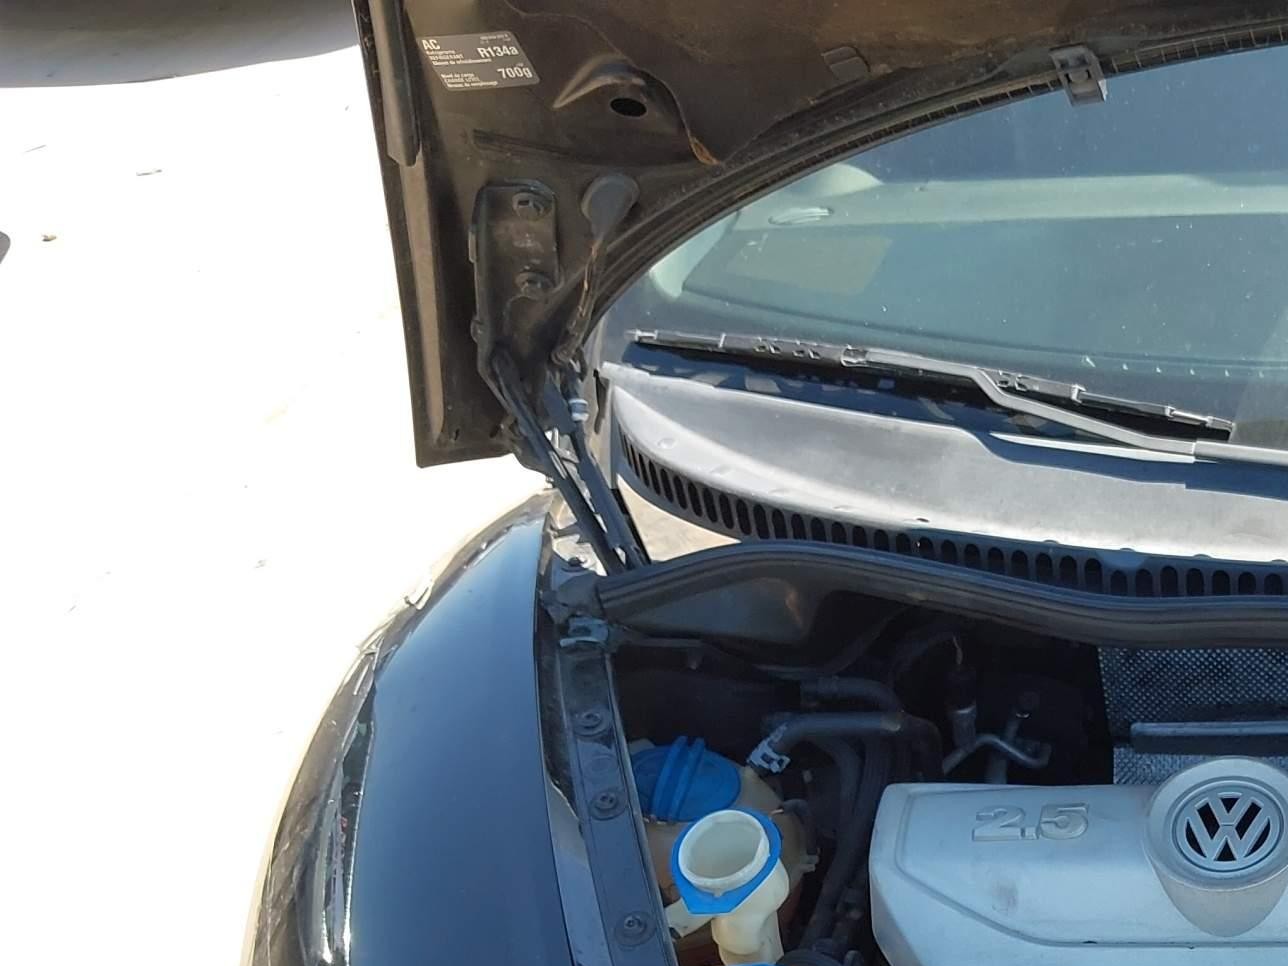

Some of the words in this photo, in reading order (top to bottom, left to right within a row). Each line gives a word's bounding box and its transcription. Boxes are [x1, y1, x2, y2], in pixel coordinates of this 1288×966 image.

[422, 39, 440, 50] AC
[476, 45, 519, 58] R134a
[496, 66, 533, 79] 700g
[971, 802, 1090, 842] 2.5
